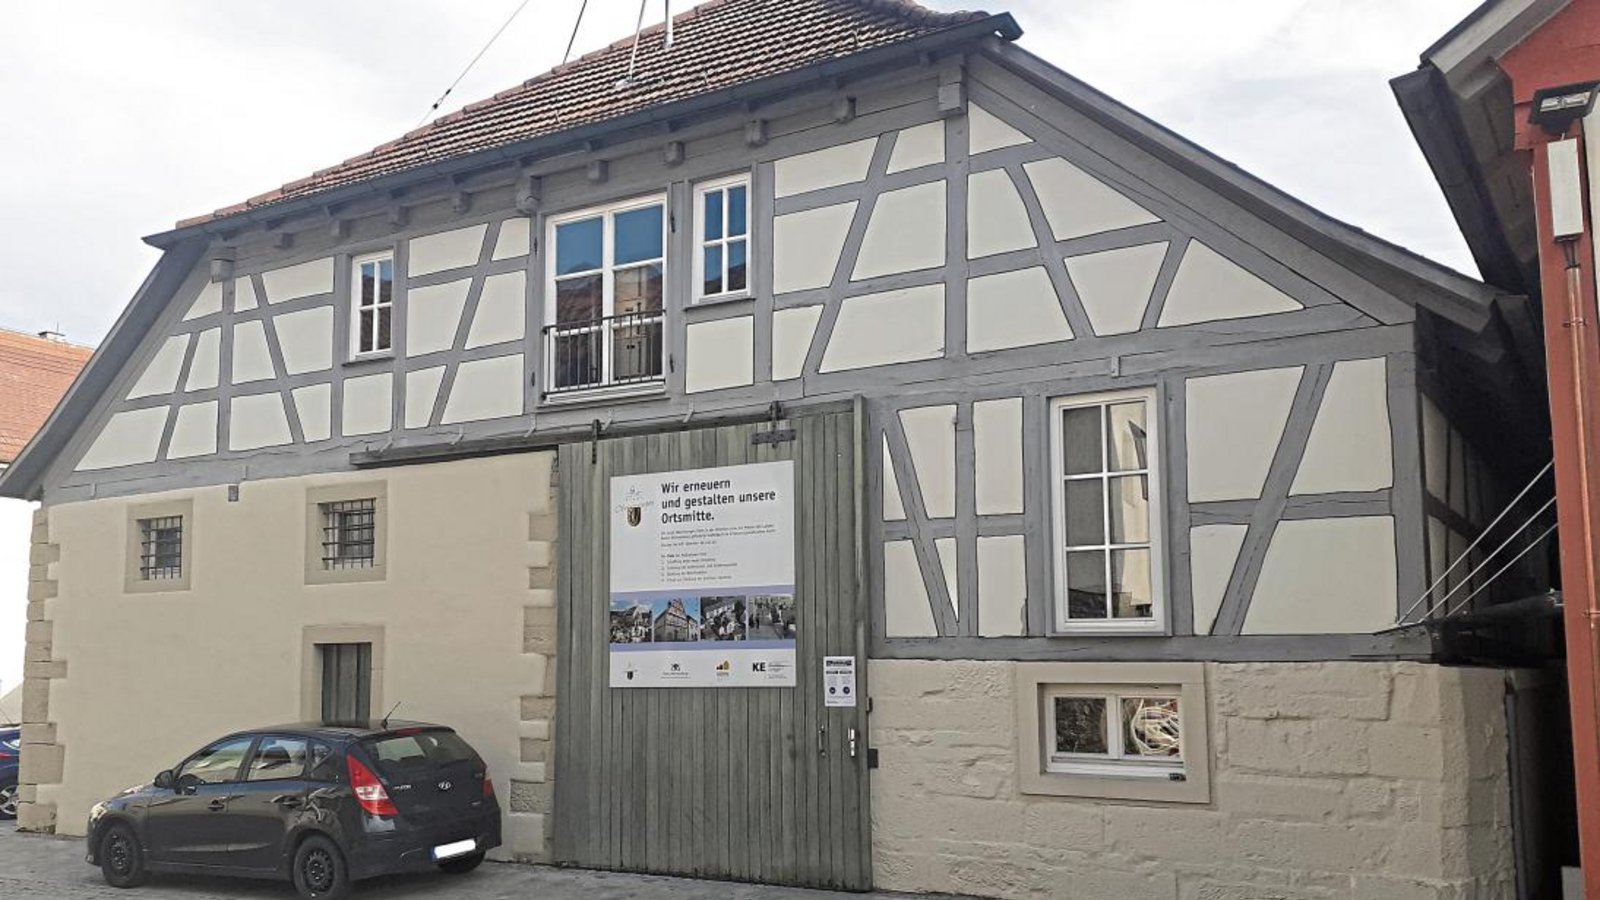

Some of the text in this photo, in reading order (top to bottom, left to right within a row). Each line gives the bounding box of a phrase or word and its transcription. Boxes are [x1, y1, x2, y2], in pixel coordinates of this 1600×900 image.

[661, 479, 731, 494] Wir erneuern
[662, 497, 681, 509] und
[684, 493, 735, 510] gestalten
[739, 490, 776, 503] unsere
[661, 510, 715, 524] Ortsmitte.
[752, 661, 766, 672] KE
